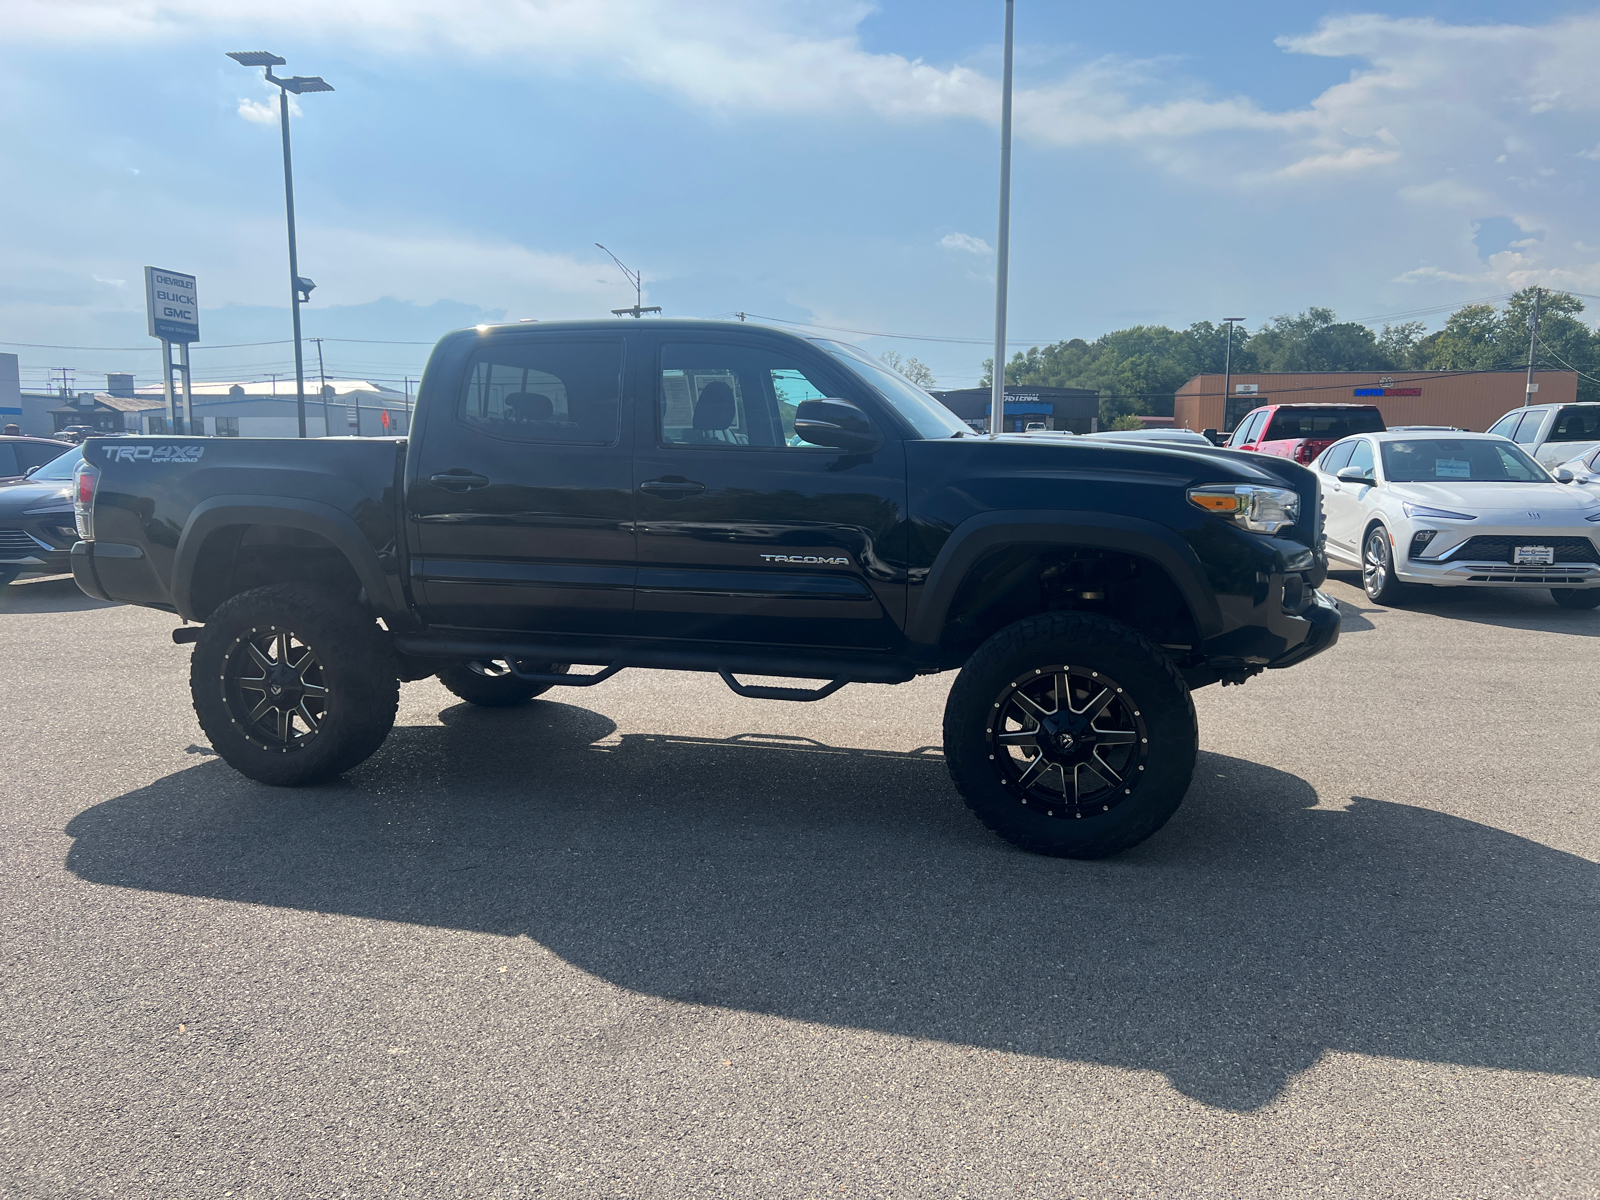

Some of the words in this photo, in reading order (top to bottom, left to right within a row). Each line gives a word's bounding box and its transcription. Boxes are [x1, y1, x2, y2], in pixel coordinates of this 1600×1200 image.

[156, 275, 193, 290] CHEVROLET
[157, 290, 195, 305] BUICK
[163, 307, 192, 320] GMC
[1353, 388, 1383, 397] SUPER
[1384, 387, 1422, 397] BOUNCE
[101, 445, 154, 463] TRD
[759, 554, 850, 566] TACOMA
